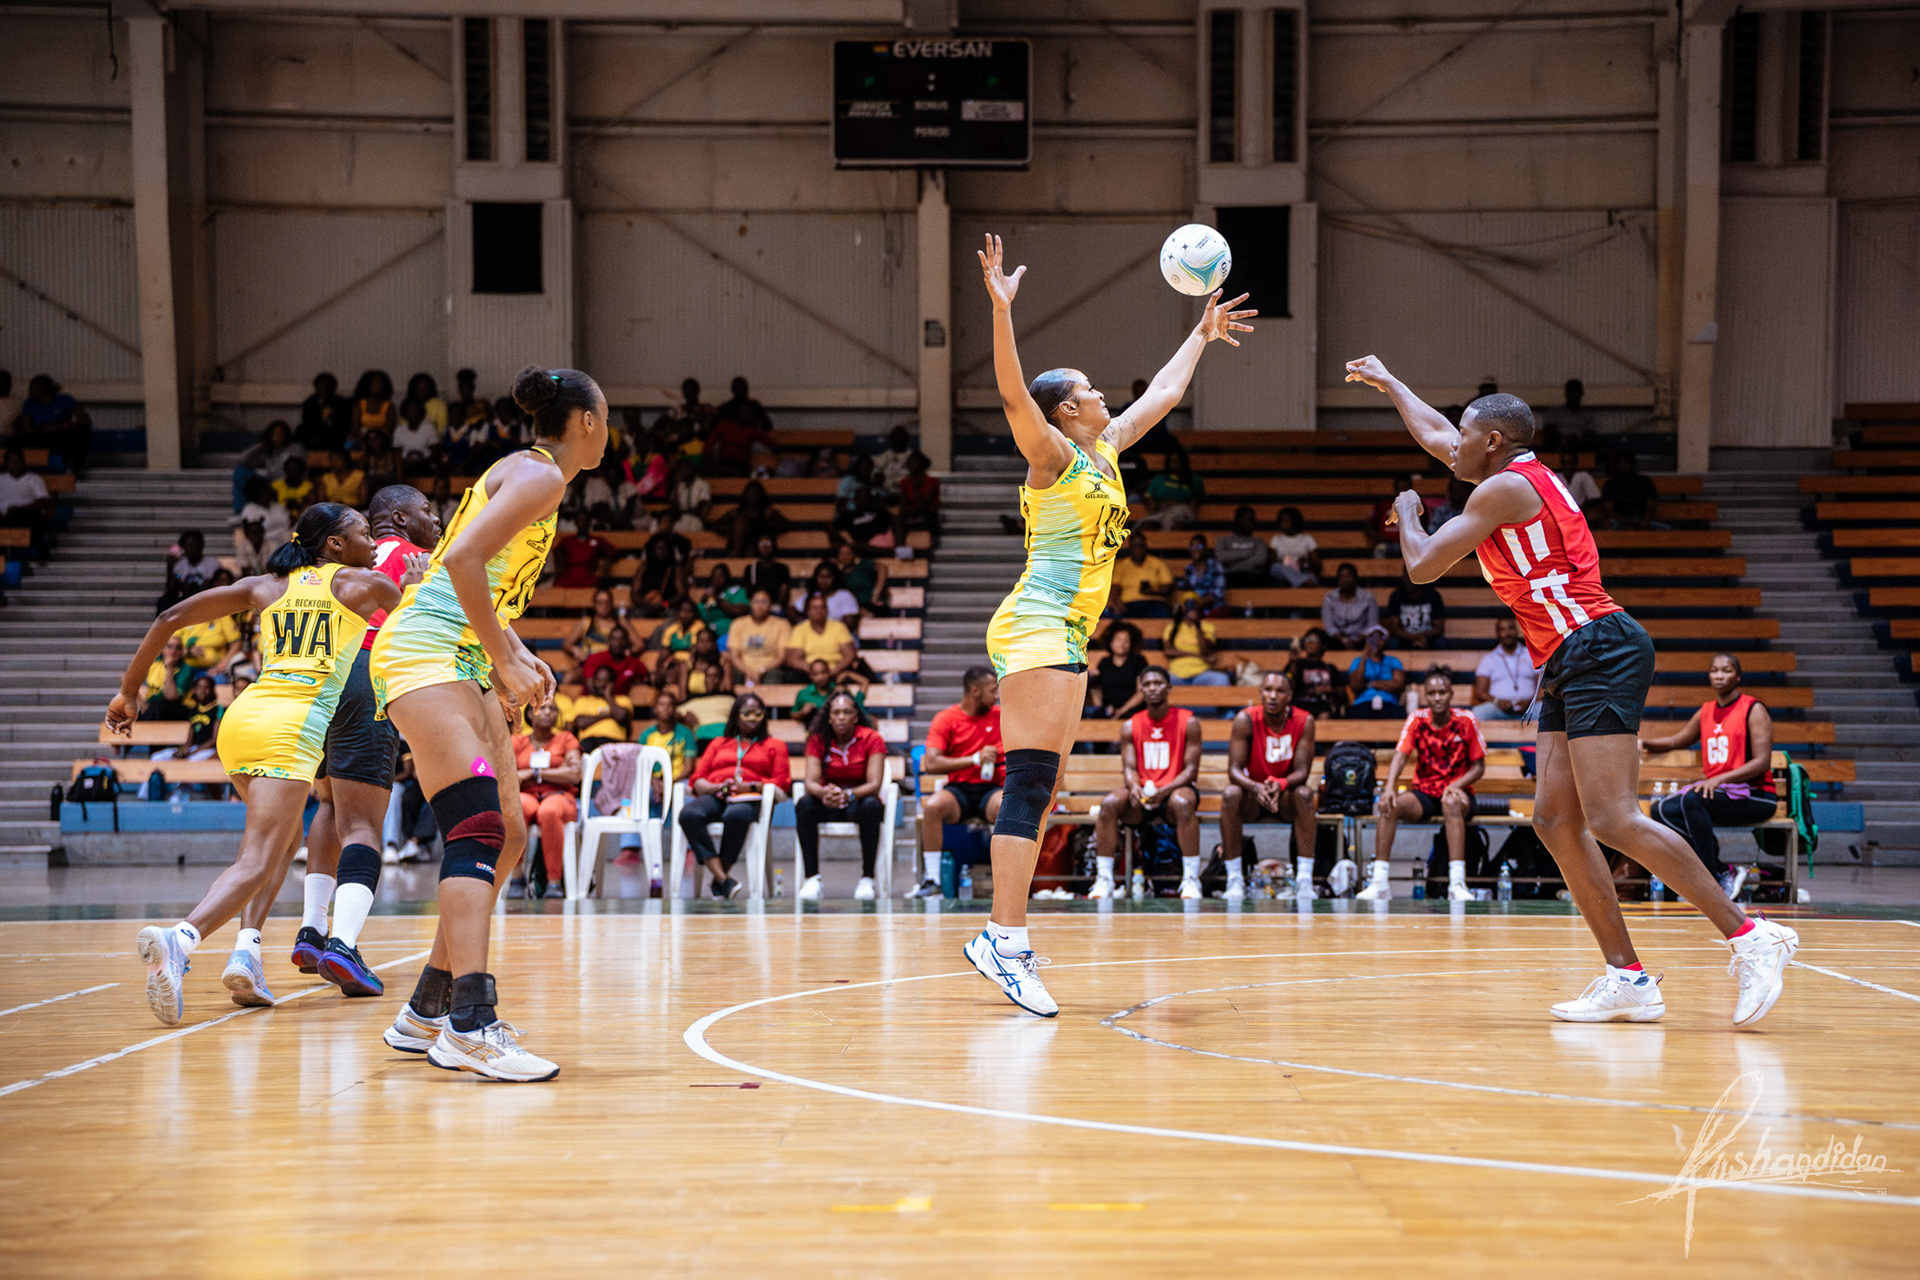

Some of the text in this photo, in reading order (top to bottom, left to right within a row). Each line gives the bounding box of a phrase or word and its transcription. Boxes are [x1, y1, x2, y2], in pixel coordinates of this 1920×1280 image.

[892, 40, 993, 58] EVERSAN
[286, 599, 332, 609] S. BECKFORD
[270, 611, 333, 658] WA
[1143, 741, 1169, 769] WD
[1708, 736, 1728, 764] GS
